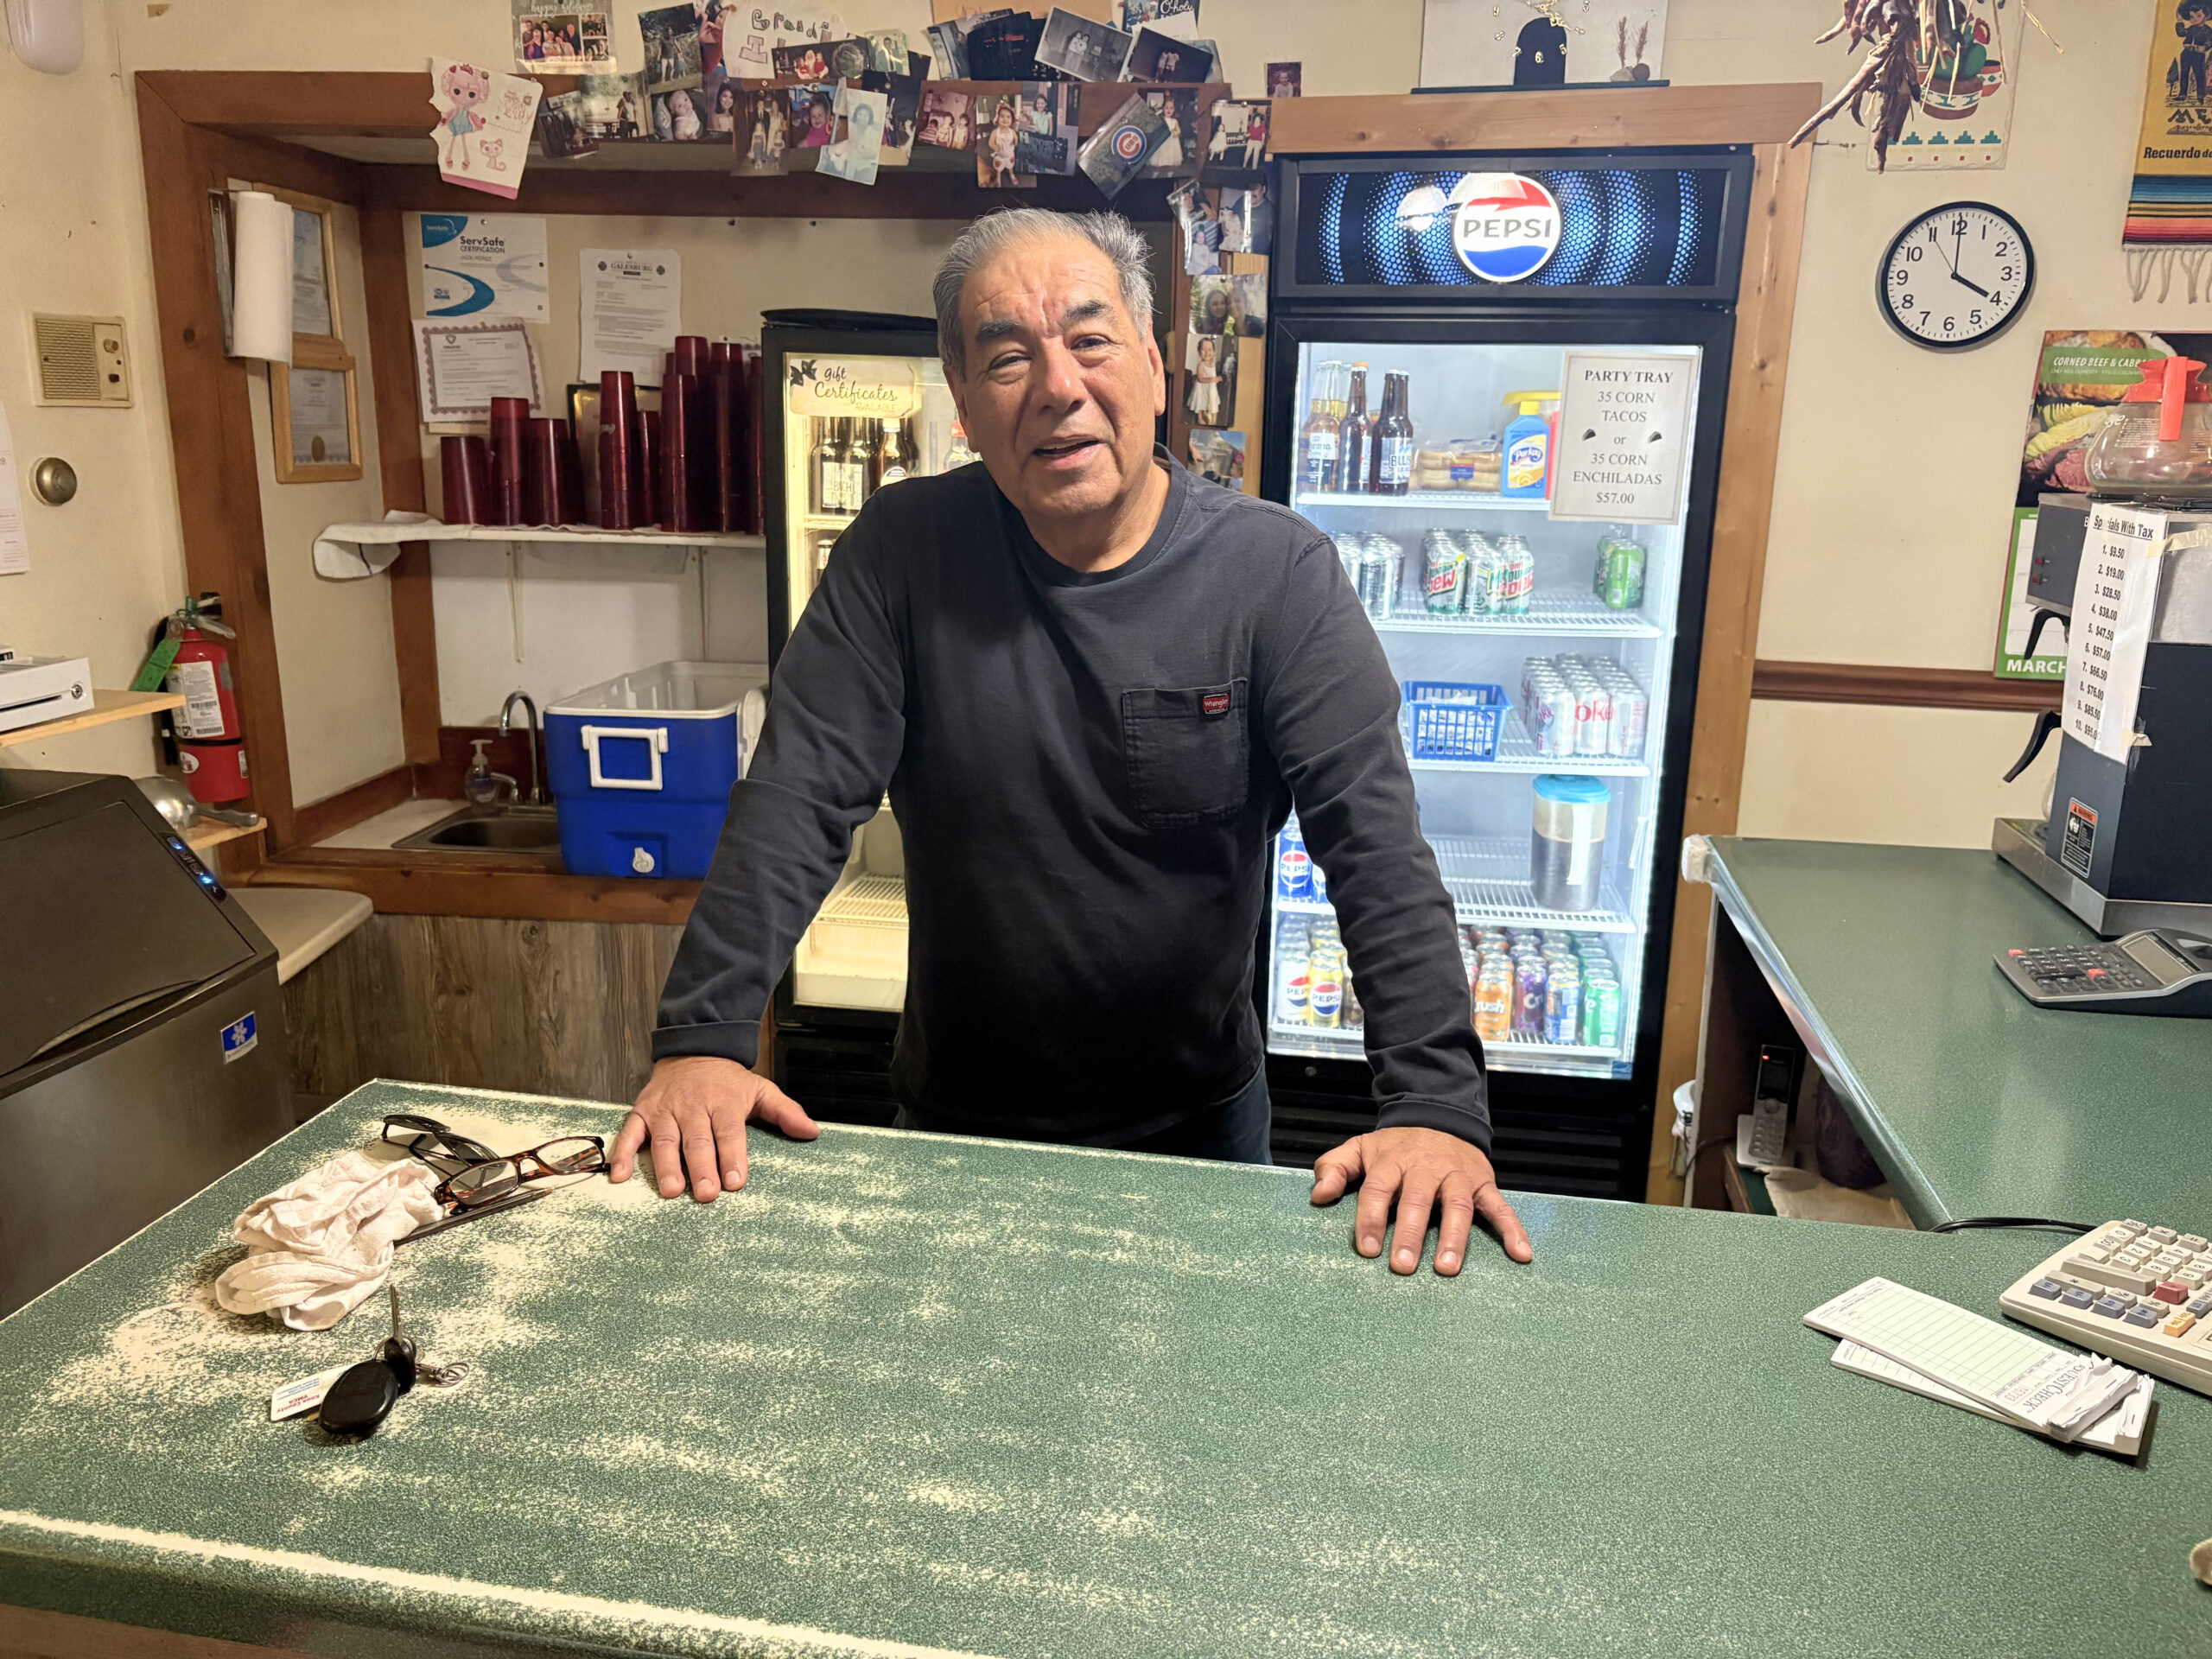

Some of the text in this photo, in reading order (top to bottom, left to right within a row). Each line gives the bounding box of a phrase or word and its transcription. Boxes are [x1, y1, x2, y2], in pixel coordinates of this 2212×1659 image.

[2144, 147, 2201, 159] Recuerdo
[1463, 218, 1552, 238] PEPSI
[1929, 226, 1937, 242] 11
[1951, 219, 1967, 235] 12
[460, 236, 505, 247] ServSafe
[460, 245, 505, 254] CERTIFICATION
[1906, 246, 1923, 262] 10
[1995, 242, 2007, 257] 2
[1897, 270, 1909, 285] 9
[2000, 266, 2012, 281] 3
[1902, 294, 1914, 309] 8
[1989, 291, 2002, 306] 4
[1920, 311, 1930, 326] 7
[1943, 316, 1955, 331] 6
[1969, 309, 1982, 325] 5
[2054, 357, 2086, 366] CORNED
[2088, 358, 2110, 367] BEEF
[2110, 359, 2116, 367] &
[1585, 370, 1673, 384] PARTY TRAY
[814, 380, 898, 404] Certificates
[1598, 391, 1656, 404] 35 CORN
[1602, 410, 1647, 422] TACOS
[1591, 454, 1648, 465] 35 CORN
[1573, 471, 1662, 485] ENCHILADAS
[1596, 493, 1634, 504] $57.00
[2120, 519, 2135, 535] With
[2138, 524, 2154, 538] Tax
[2110, 546, 2125, 559] $9.50
[2098, 564, 2125, 580] 2. $19.00
[2094, 583, 2120, 601] 3. $28.50
[2091, 604, 2117, 620] 4. $38.00
[2088, 623, 2113, 641] 5. $47.50
[2085, 642, 2111, 661] 6. $57.00
[2006, 659, 2067, 674] MARCH
[2082, 662, 2107, 681] 7. $66.50
[2088, 684, 2104, 701] $76.00
[1204, 697, 1229, 709] Wrangler
[2084, 703, 2101, 720] $85.50
[2084, 724, 2101, 741] $95.0
[1474, 1000, 1505, 1014] rush
[289, 1395, 308, 1404] YMCA
[277, 1402, 301, 1413] County
